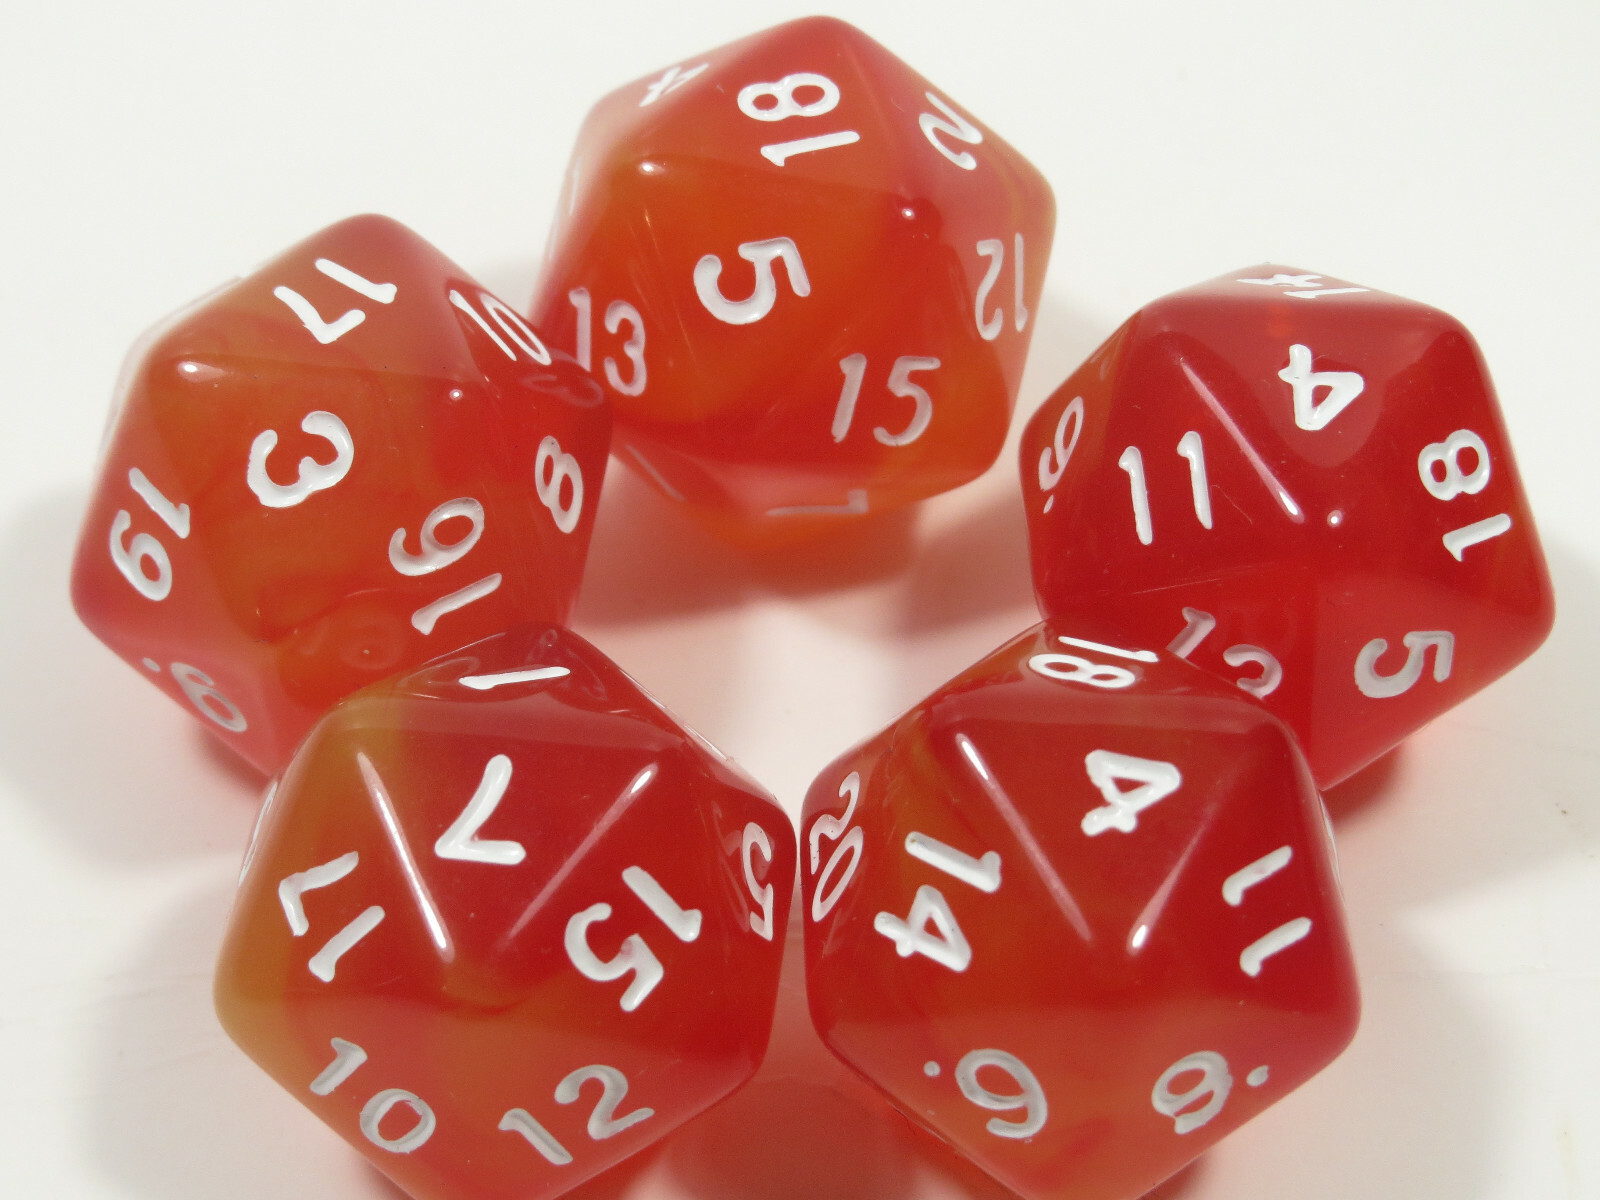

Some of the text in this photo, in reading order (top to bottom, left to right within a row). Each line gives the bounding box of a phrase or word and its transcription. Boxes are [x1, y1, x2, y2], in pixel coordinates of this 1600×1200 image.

[737, 72, 860, 167] 18
[918, 92, 983, 170] 2
[274, 258, 397, 343] 17
[449, 289, 552, 366] 10
[693, 236, 811, 325] 5
[974, 233, 1029, 341] 12
[568, 287, 647, 397] 13
[1278, 344, 1364, 430] 4
[831, 353, 941, 447] 15
[247, 410, 354, 508] 3
[535, 436, 583, 533] 8
[1118, 431, 1213, 545] 11
[1418, 429, 1511, 562] 18
[109, 467, 190, 601] 19
[389, 497, 502, 635] 16
[459, 666, 570, 689] 1
[1028, 636, 1159, 689] 18
[1354, 630, 1455, 698] 5
[434, 754, 526, 865] 7
[1080, 749, 1182, 836] 4
[742, 822, 773, 941] 5
[809, 771, 863, 922] 20
[278, 851, 385, 982] 17
[564, 865, 702, 1012] 15
[873, 831, 1001, 973] 14
[1222, 845, 1312, 976] 11
[309, 1037, 436, 1153] 10
[498, 1064, 655, 1165] 12
